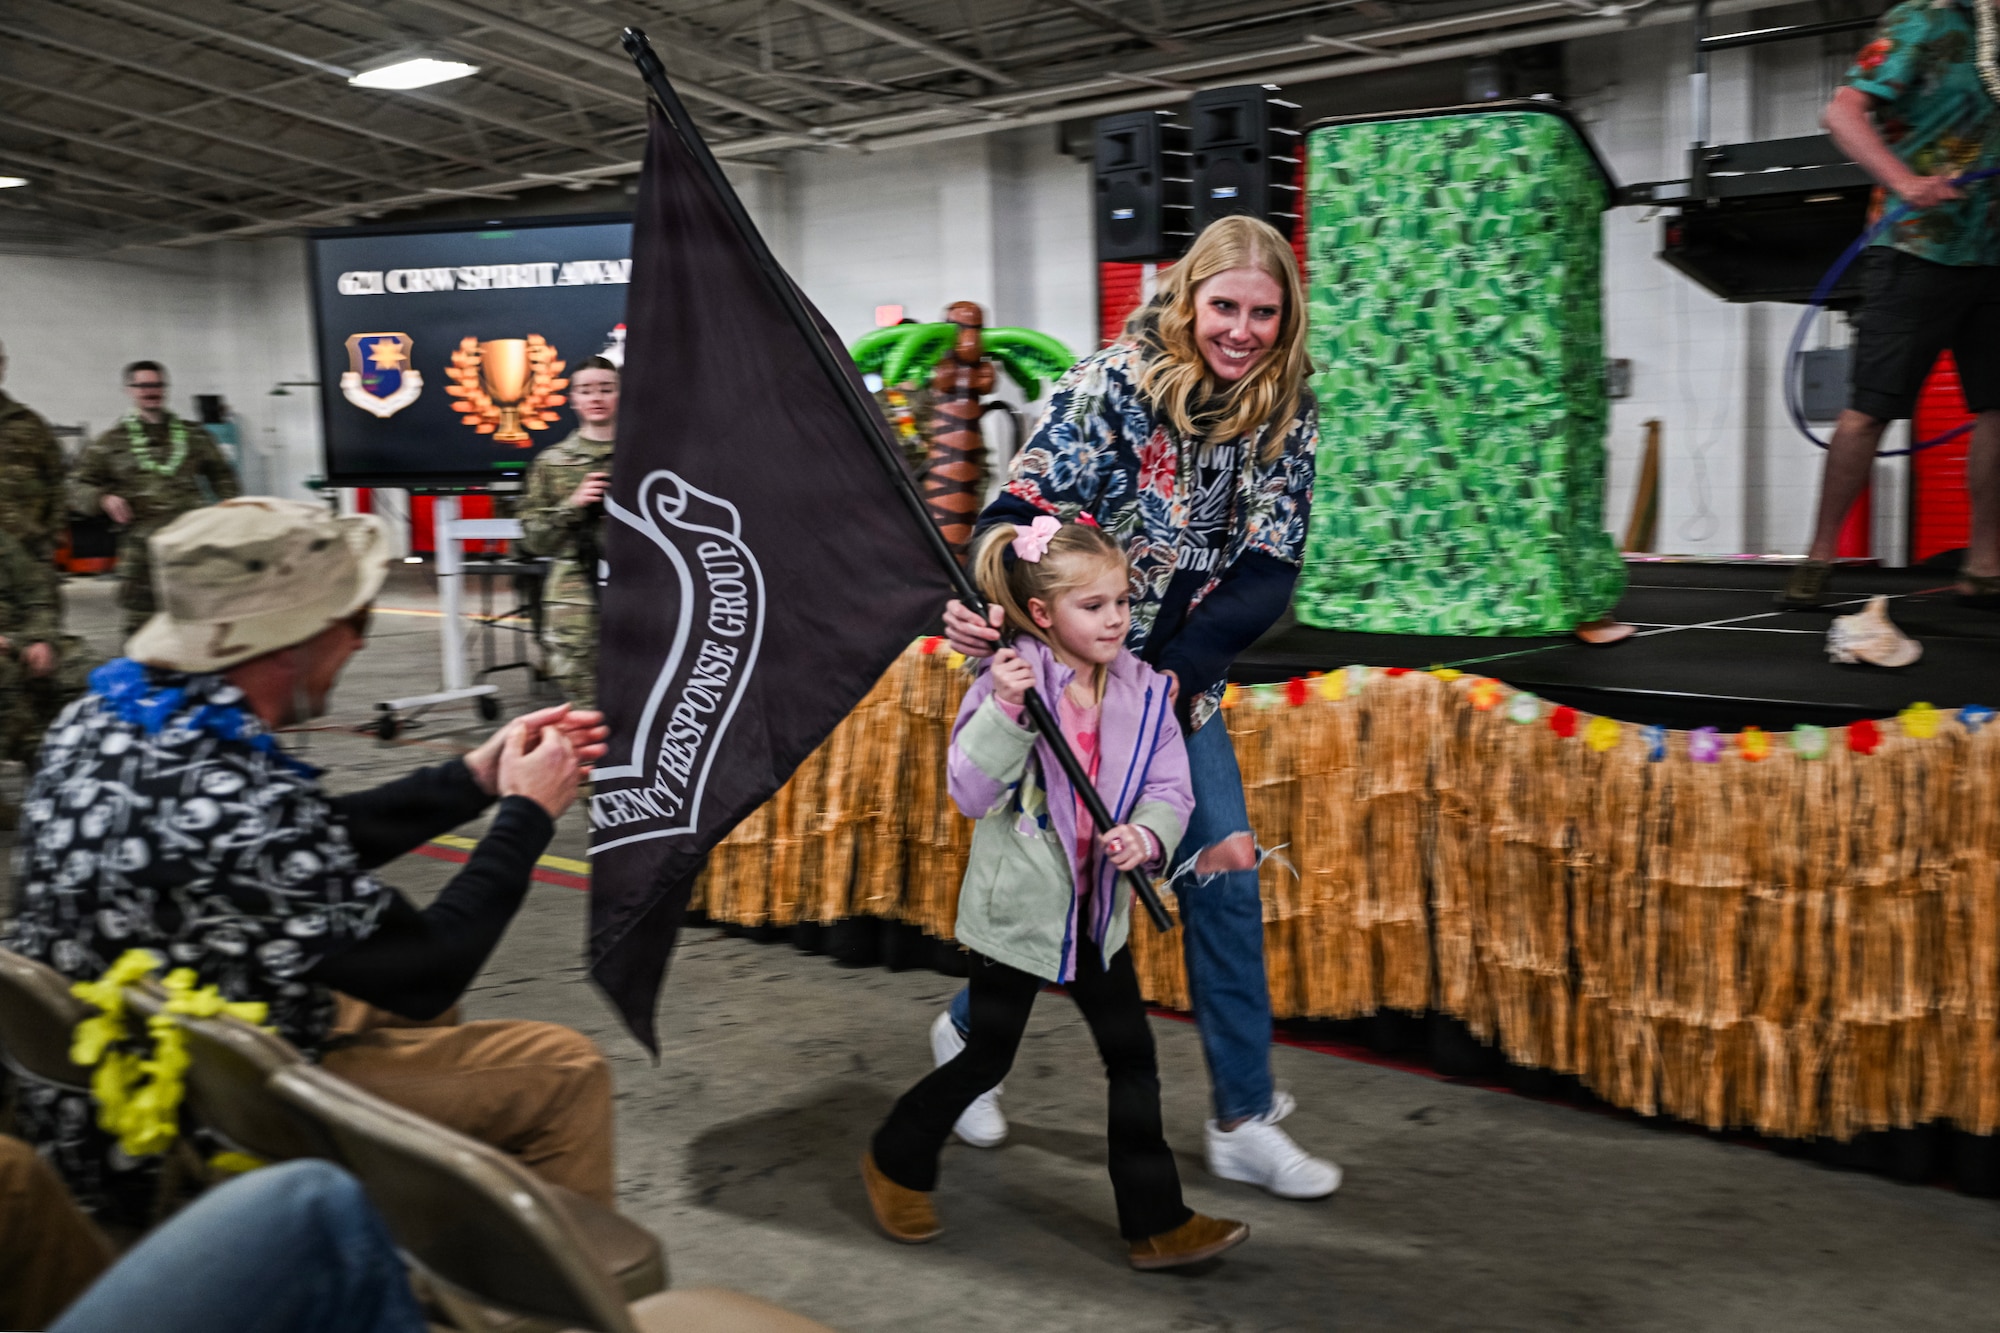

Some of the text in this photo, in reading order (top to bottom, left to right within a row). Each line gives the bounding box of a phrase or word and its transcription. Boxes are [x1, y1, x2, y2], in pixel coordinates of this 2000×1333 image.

[456, 262, 559, 291] SPIRIT
[696, 541, 749, 638] GROUP
[657, 639, 740, 789] RESPONSE
